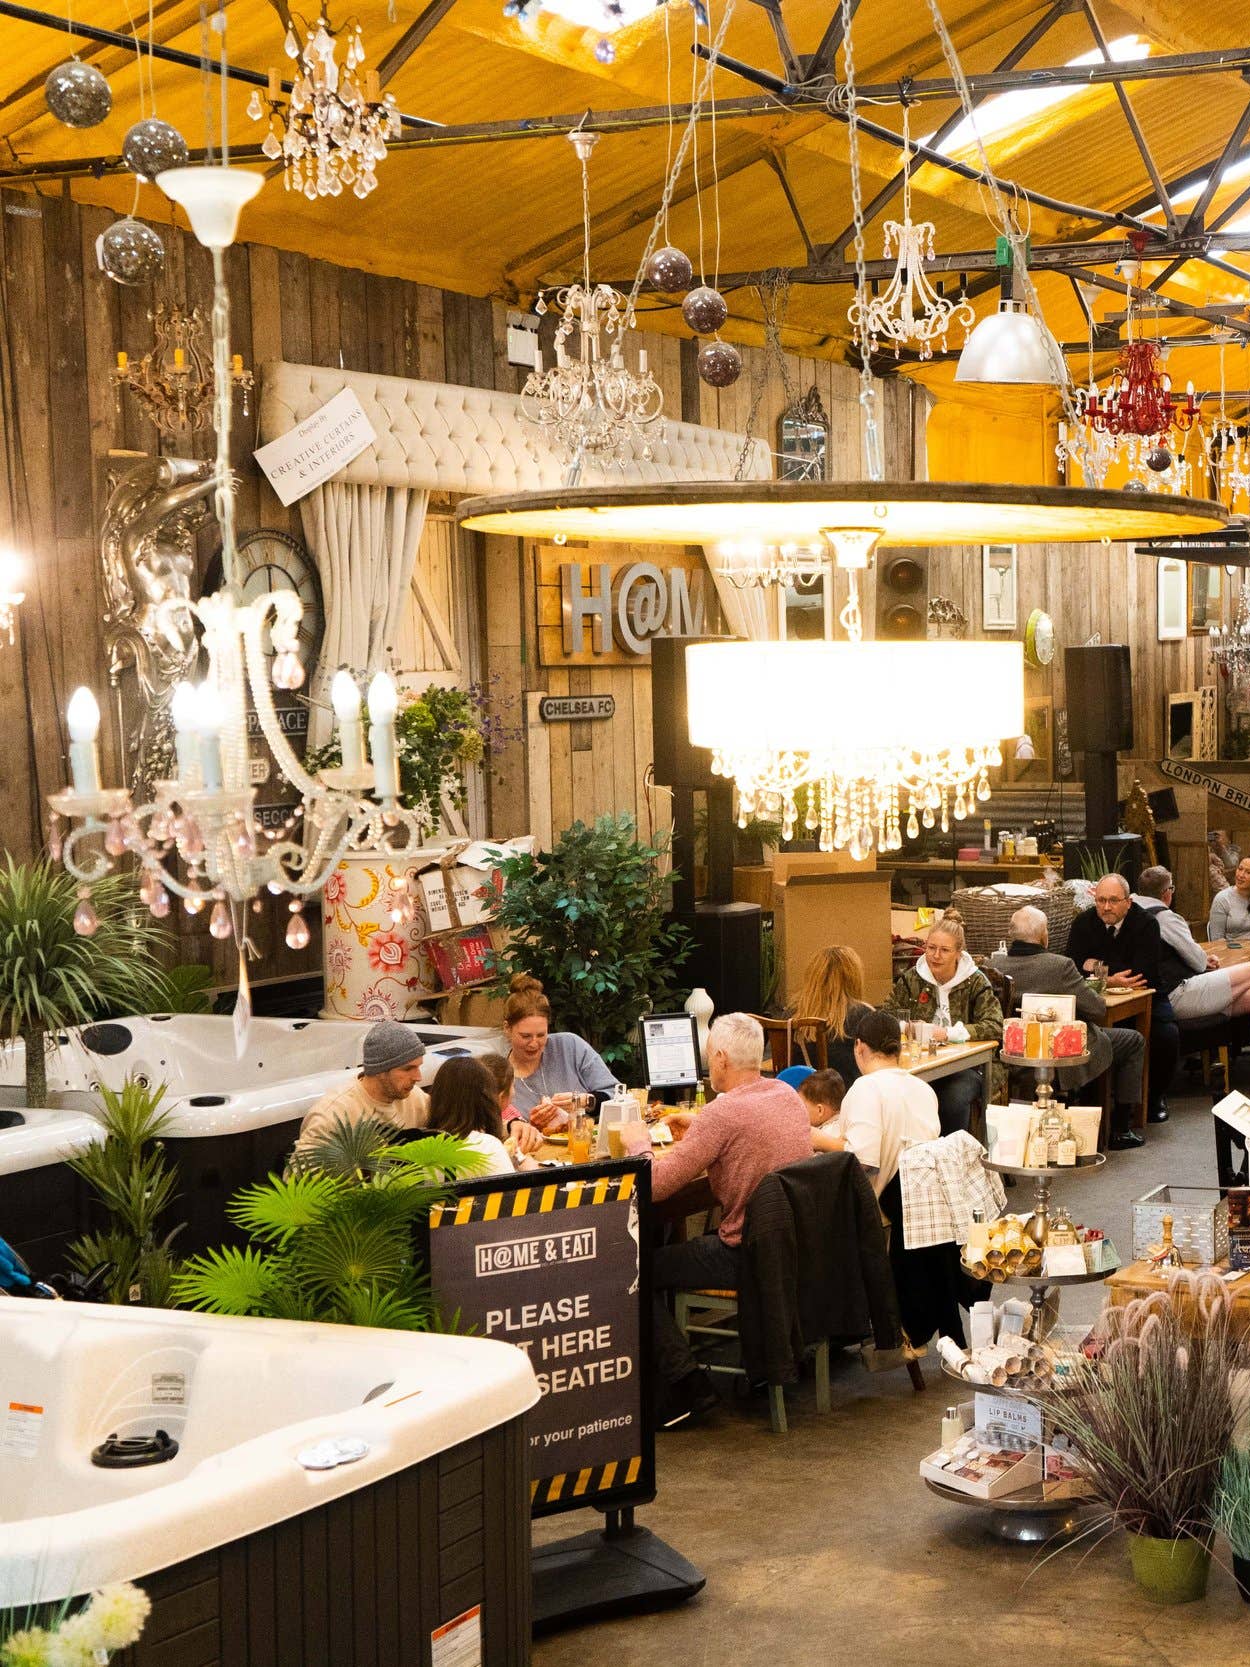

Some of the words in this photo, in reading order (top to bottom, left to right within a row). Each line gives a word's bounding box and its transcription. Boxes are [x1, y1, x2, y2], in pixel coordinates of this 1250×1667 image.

[270, 440, 321, 480] CREATIVE
[323, 408, 362, 445] CURTAINS
[299, 470, 307, 478] &
[308, 432, 355, 471] INTERIORS
[545, 700, 595, 715] CHELSEA
[598, 700, 612, 713] FC
[1165, 761, 1221, 794] LONDON
[480, 1241, 540, 1272] H@ME
[545, 1239, 557, 1261] &
[561, 1232, 591, 1259] EAT
[486, 1295, 590, 1334] PLEASE
[542, 1325, 611, 1360] HERE
[535, 1356, 632, 1397] SEATED
[544, 1428, 575, 1447] your
[578, 1414, 632, 1439] patience
[989, 1408, 1001, 1417] LIP
[1003, 1411, 1027, 1423] BALMS
